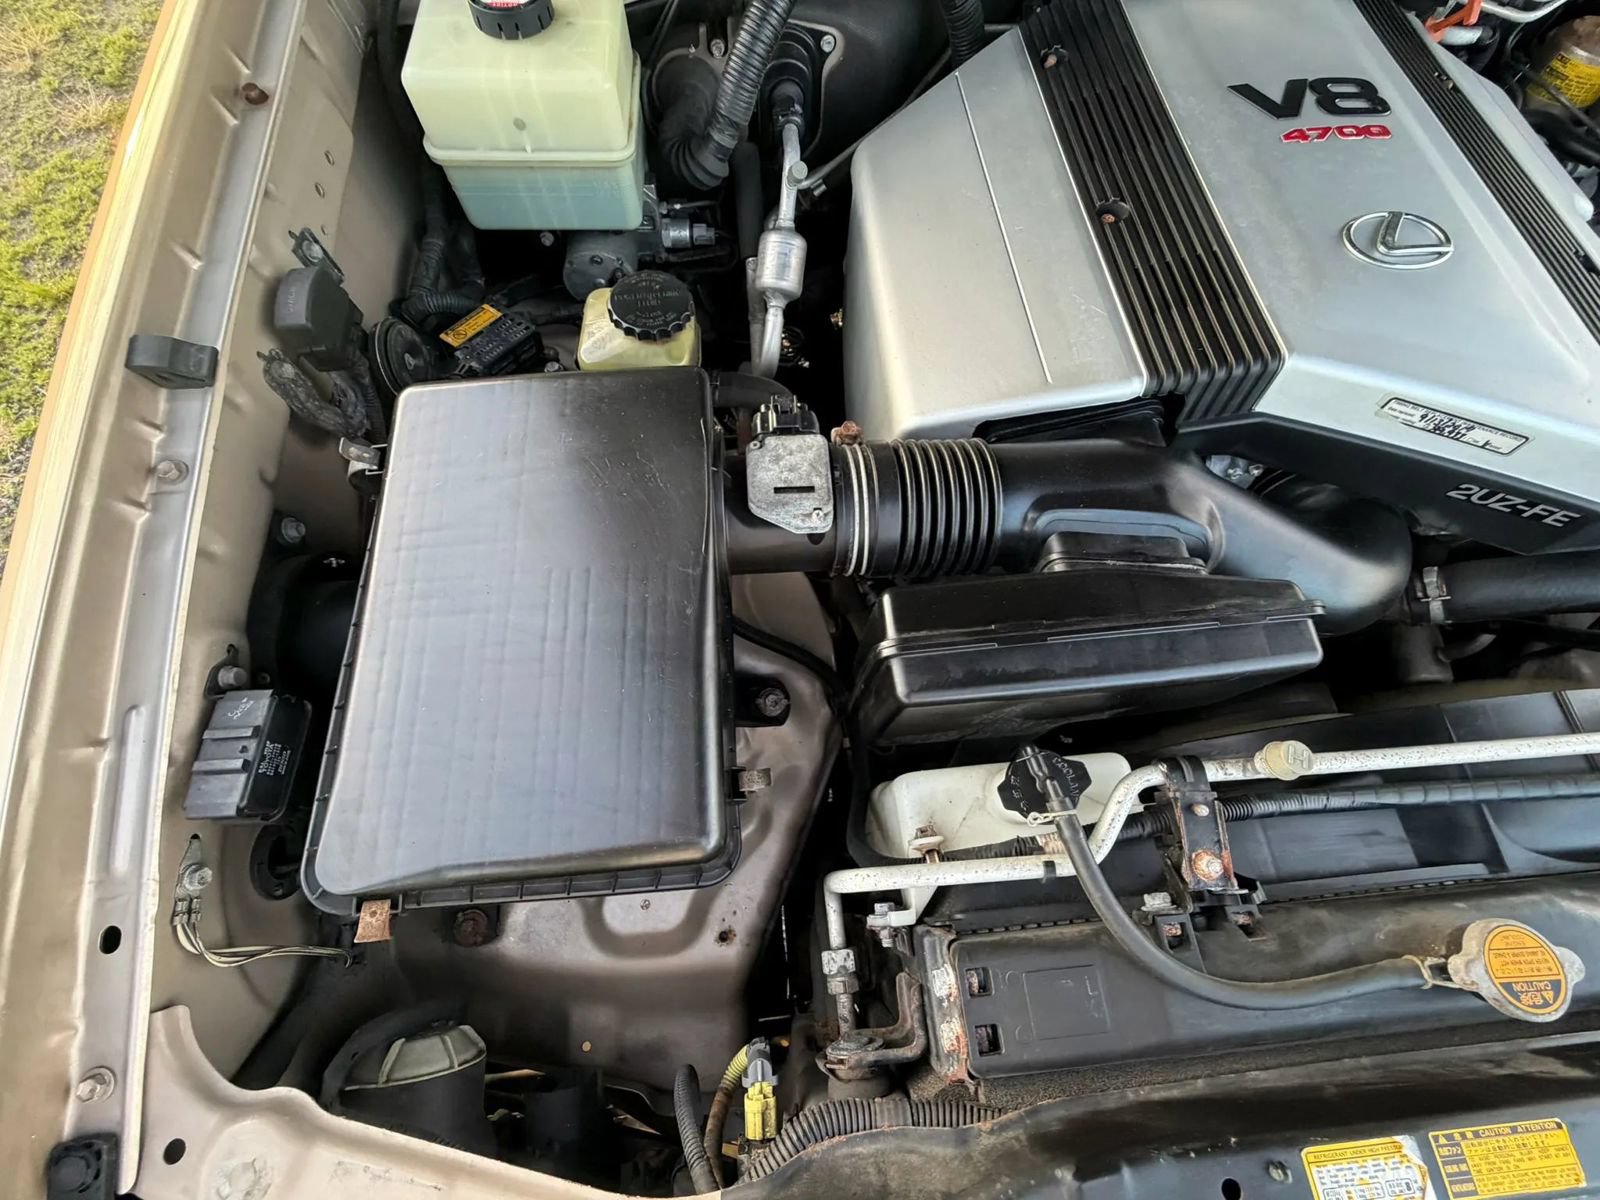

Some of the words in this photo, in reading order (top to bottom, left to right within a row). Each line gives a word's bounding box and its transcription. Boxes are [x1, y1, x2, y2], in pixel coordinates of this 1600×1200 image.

[1227, 77, 1392, 120] V8
[1280, 125, 1392, 143] 4700
[1445, 483, 1582, 527] 2UZ-FE
[1511, 981, 1552, 993] CAUTION
[1478, 1126, 1512, 1138] CAUTION
[1516, 1121, 1559, 1133] ATTENTION
